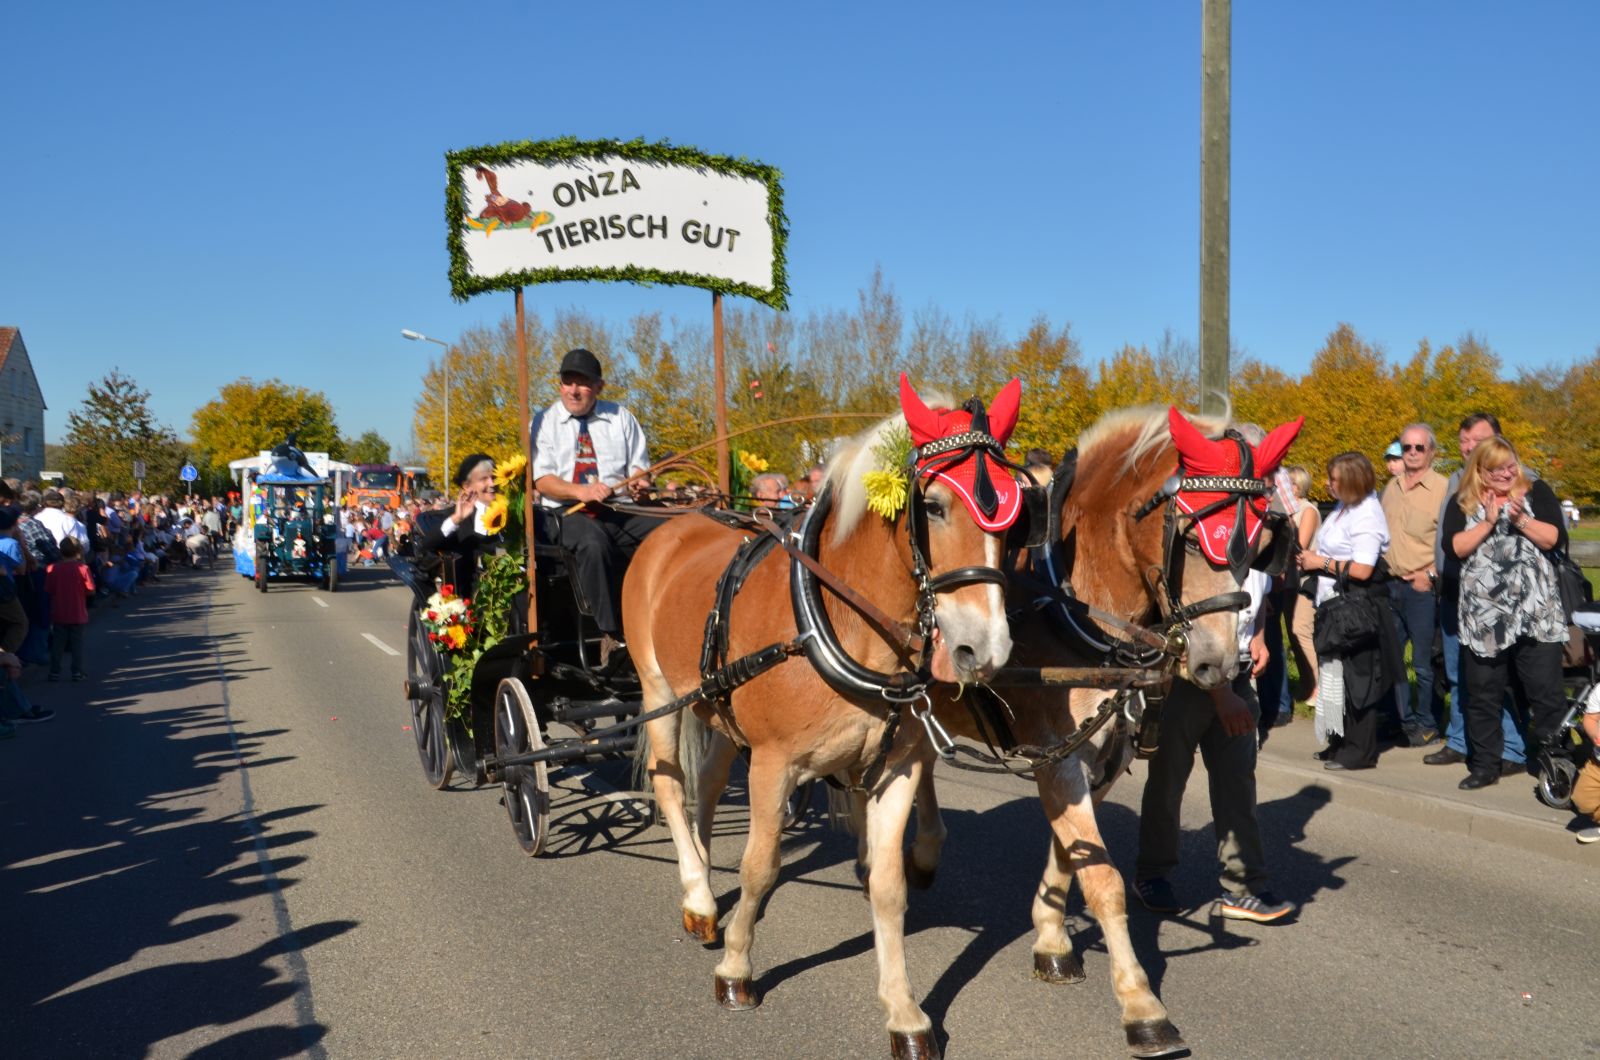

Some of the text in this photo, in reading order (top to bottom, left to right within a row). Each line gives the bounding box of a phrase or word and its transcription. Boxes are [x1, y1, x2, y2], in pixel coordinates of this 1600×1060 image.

[552, 168, 640, 207] ONZA
[536, 214, 741, 253] TIERISCH GUT
